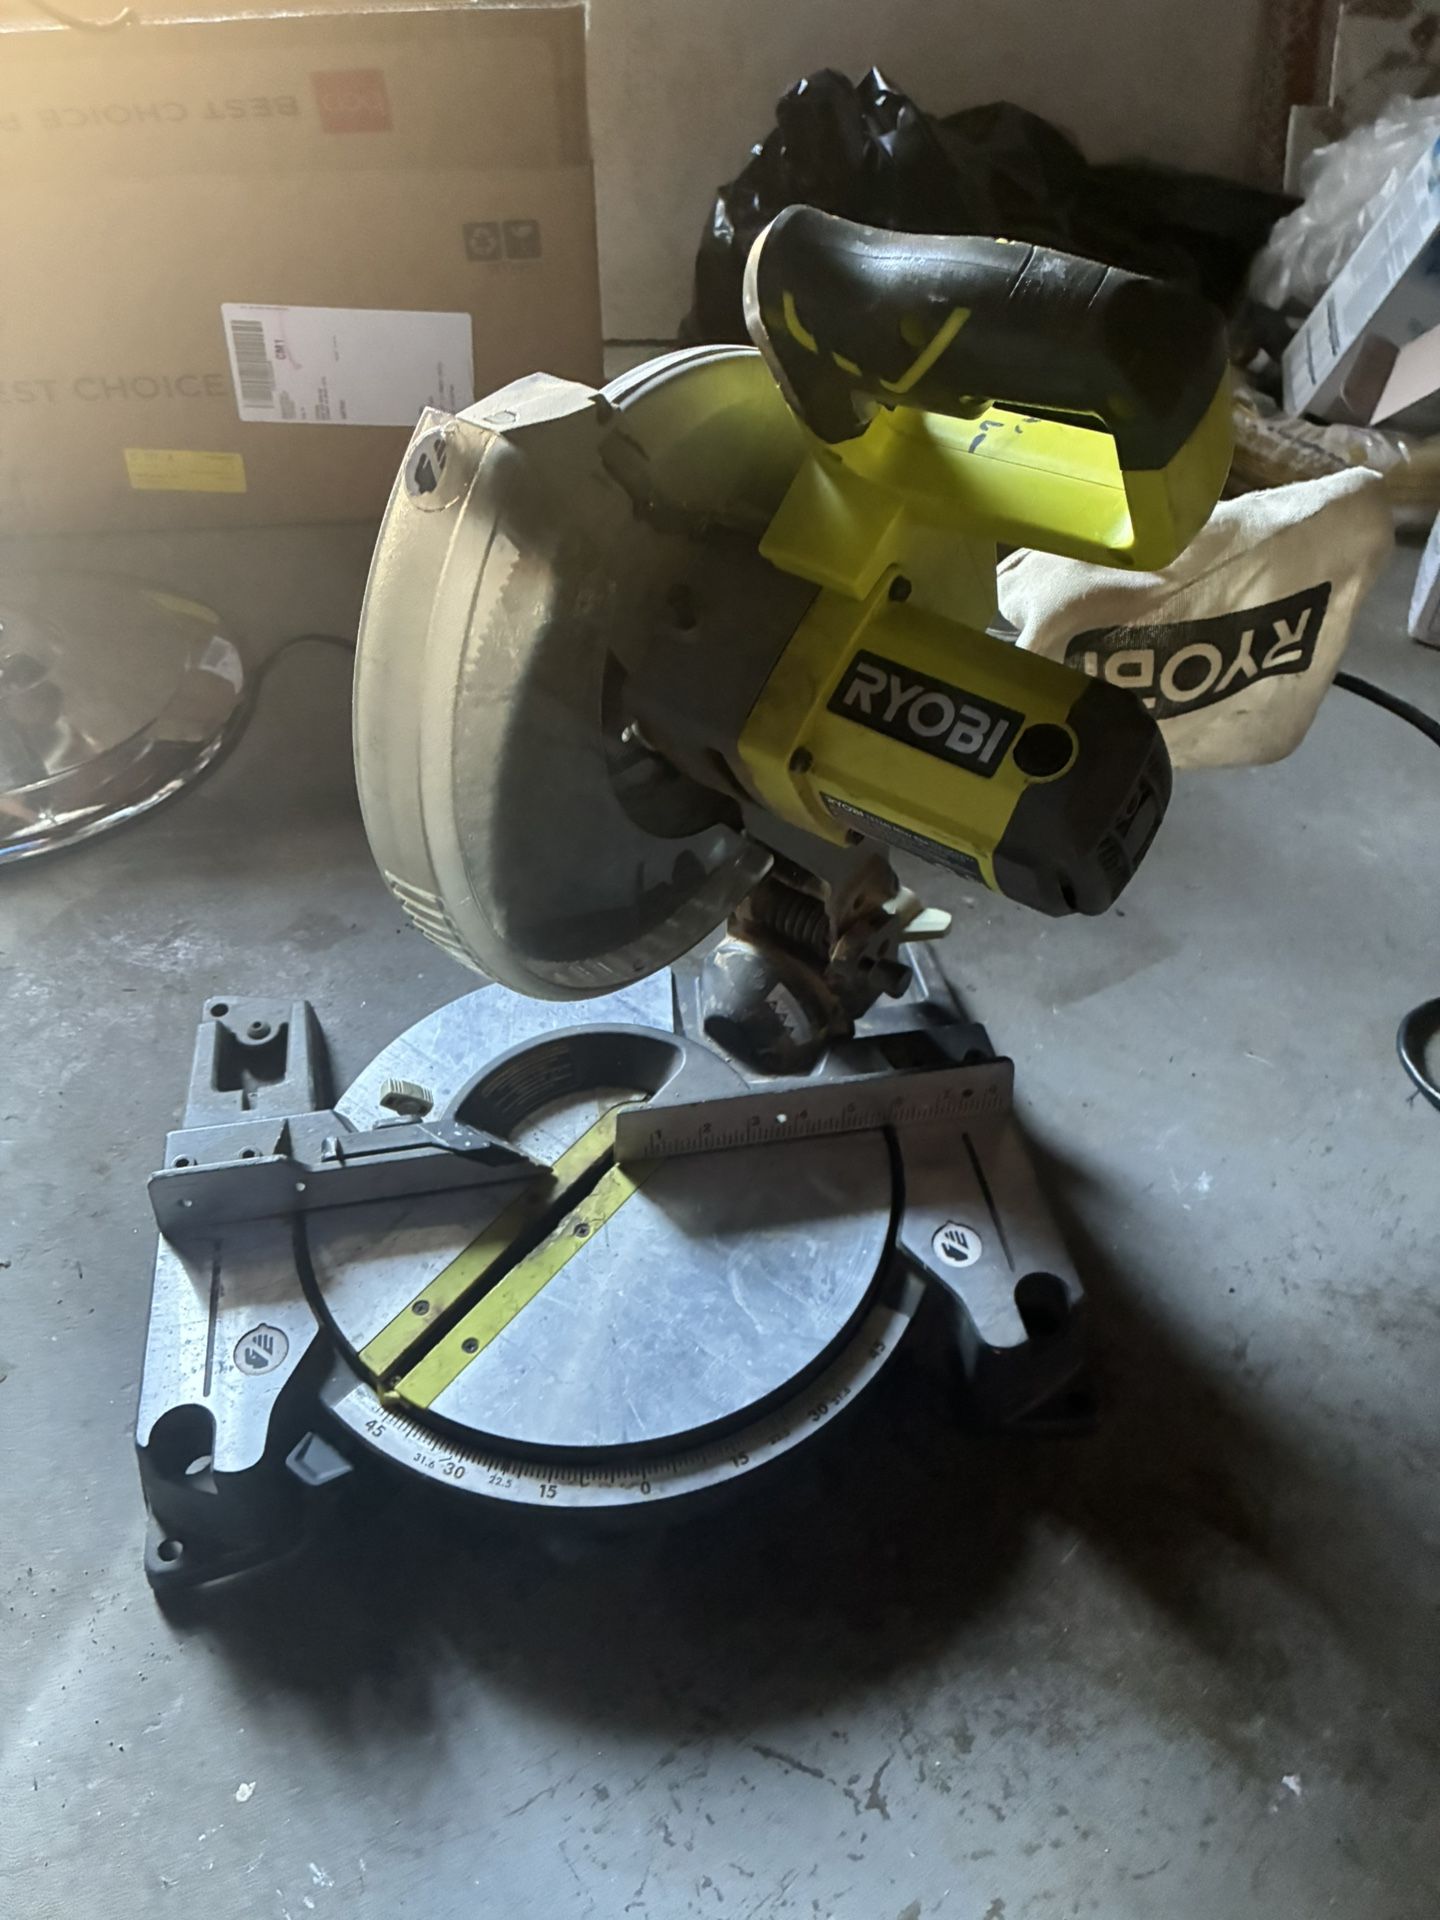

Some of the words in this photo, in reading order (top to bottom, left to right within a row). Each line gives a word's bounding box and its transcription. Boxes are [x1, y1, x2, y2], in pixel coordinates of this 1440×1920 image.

[203, 96, 299, 120] BEST
[74, 374, 229, 401] CHOICE
[843, 662, 1009, 763] RYOBI
[365, 1418, 386, 1438] 45
[413, 1452, 435, 1470] 31.6
[443, 1461, 466, 1480] 30
[539, 1484, 557, 1499] 15
[640, 1481, 651, 1495] 0
[731, 1453, 750, 1468] 15
[807, 1403, 829, 1423] 30
